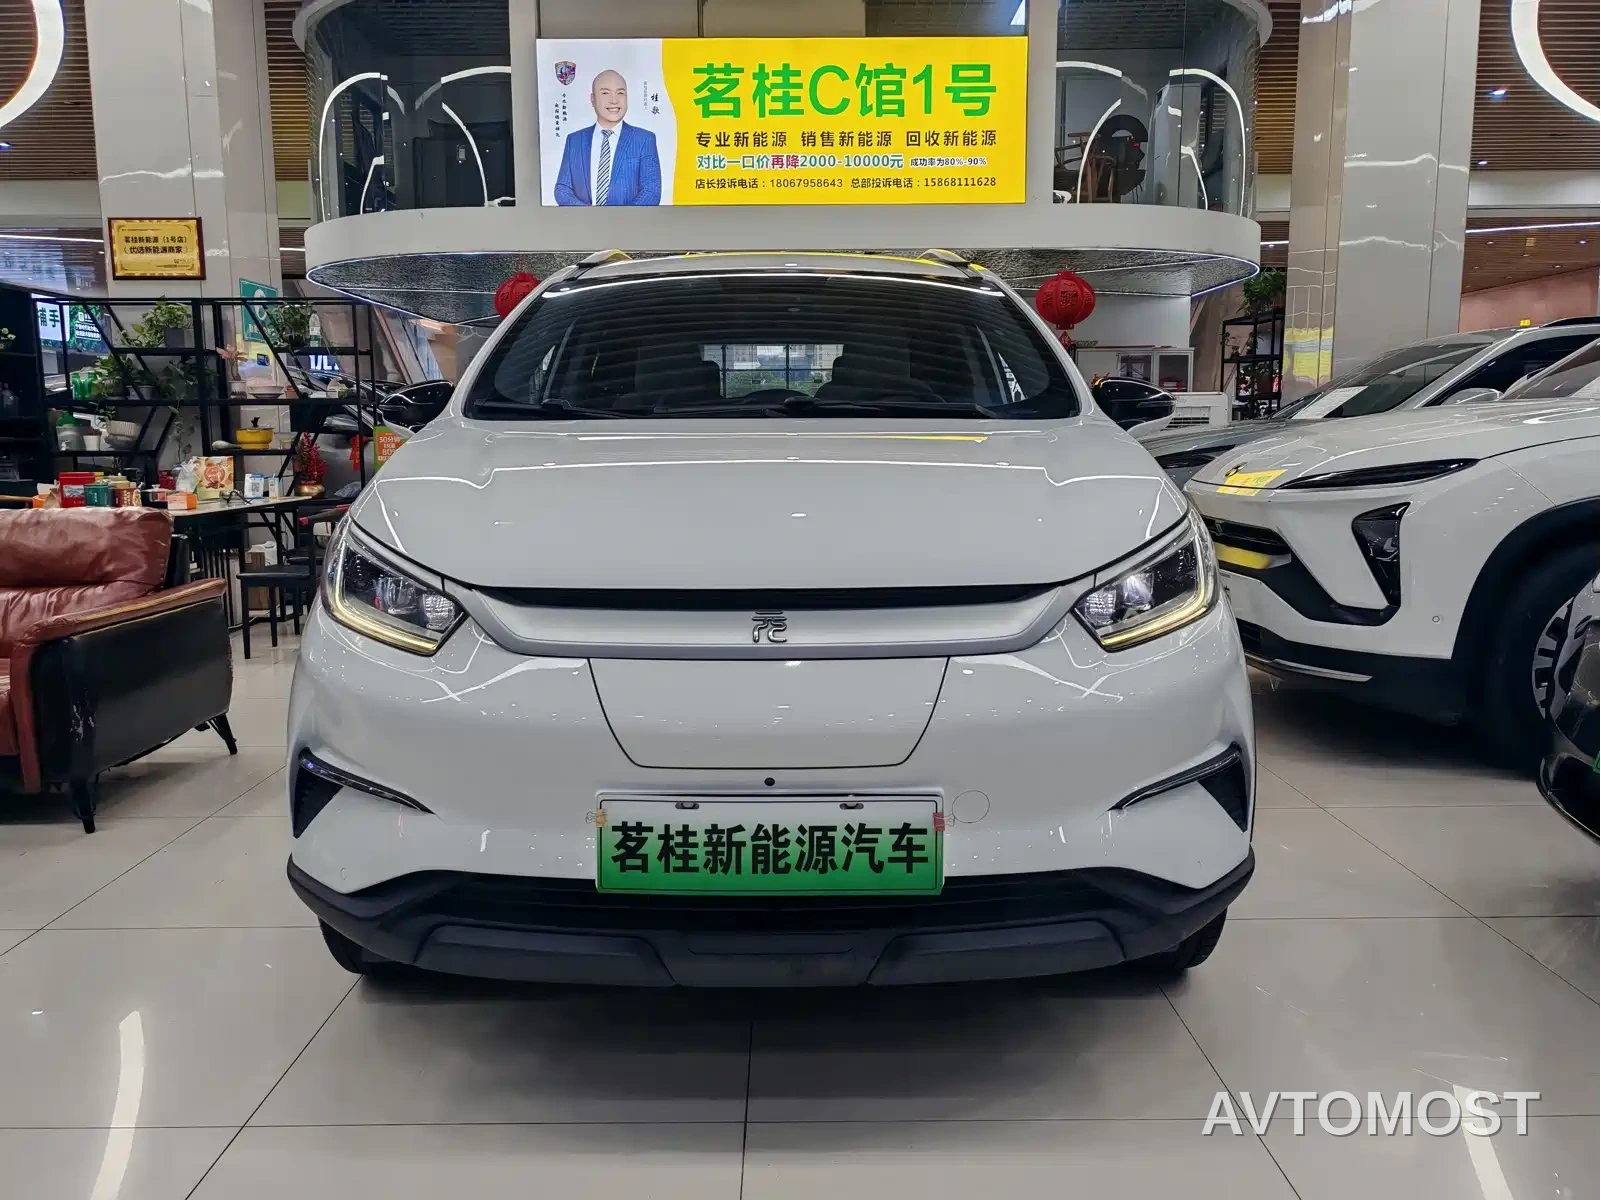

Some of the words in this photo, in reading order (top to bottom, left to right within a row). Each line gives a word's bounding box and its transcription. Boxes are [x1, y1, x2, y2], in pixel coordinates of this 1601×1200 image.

[692, 62, 998, 119] 茗桂C馆1号
[695, 130, 788, 148] 专业新能源
[801, 129, 893, 148] 销售新能源
[905, 129, 998, 147] 回收新能源
[696, 153, 904, 170] 对比一口价再降2000-10000元
[910, 157, 987, 168] 成功率为80%-90%
[611, 821, 929, 875] 茗桂新能源汽车
